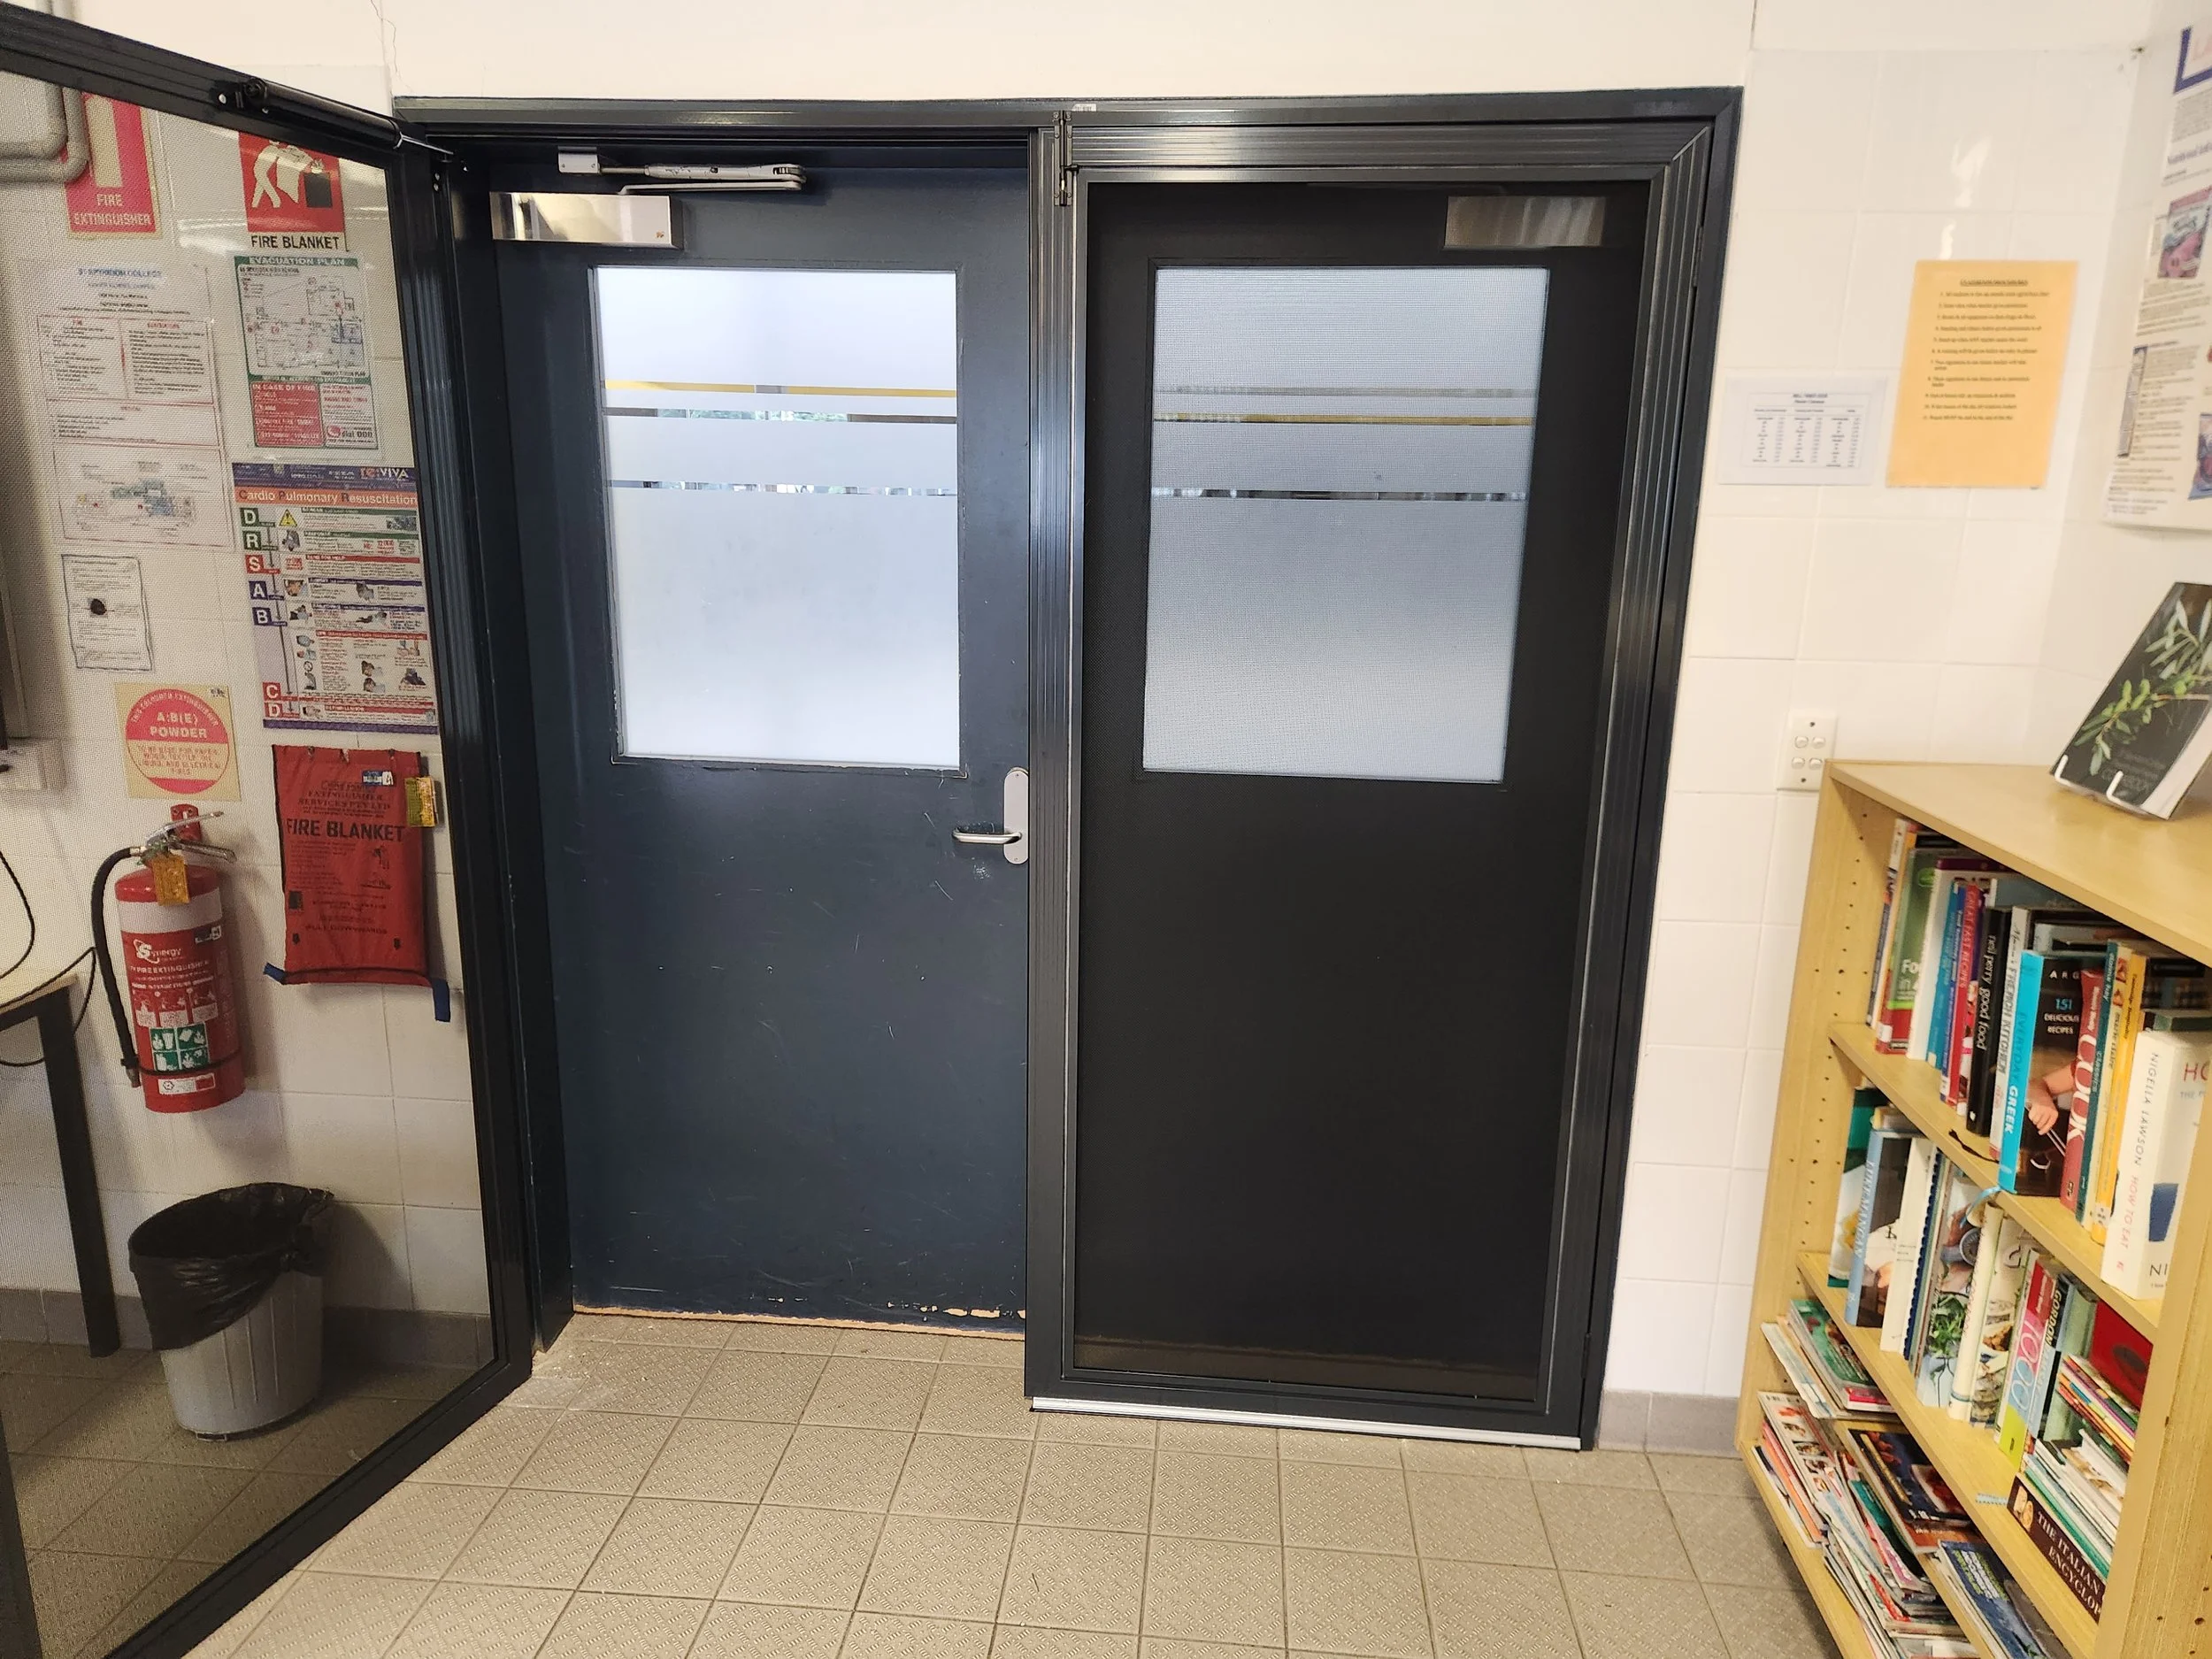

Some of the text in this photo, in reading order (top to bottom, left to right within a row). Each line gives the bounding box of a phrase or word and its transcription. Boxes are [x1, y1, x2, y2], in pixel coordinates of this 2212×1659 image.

[96, 194, 124, 206] FIRE
[251, 235, 340, 250] FIRE BLANKET
[249, 257, 314, 266] EVACUATION
[239, 490, 418, 504] Cardio Pulmonary Resuscitation
[243, 510, 257, 525] D
[247, 534, 258, 549] R
[249, 556, 261, 572] S
[253, 583, 265, 598] A
[257, 611, 268, 624] B
[266, 685, 279, 699] C
[268, 704, 280, 718] D
[150, 726, 208, 739] POWDER
[286, 818, 405, 842] FIRE BLANKET
[1976, 934, 1997, 1051] neil perry good food
[2055, 998, 2073, 1010] 151
[2047, 1025, 2074, 1034] RECIPES
[1997, 1020, 2011, 1074] KITCHEN
[2066, 1033, 2098, 1141] COOK
[2005, 1085, 2019, 1134] GREEK
[2121, 1052, 2159, 1248] NIGELLA LAWSON HOW TO EAT
[2046, 1291, 2062, 1347] GORDON
[2037, 1511, 2101, 1595] THE ITALIAN
